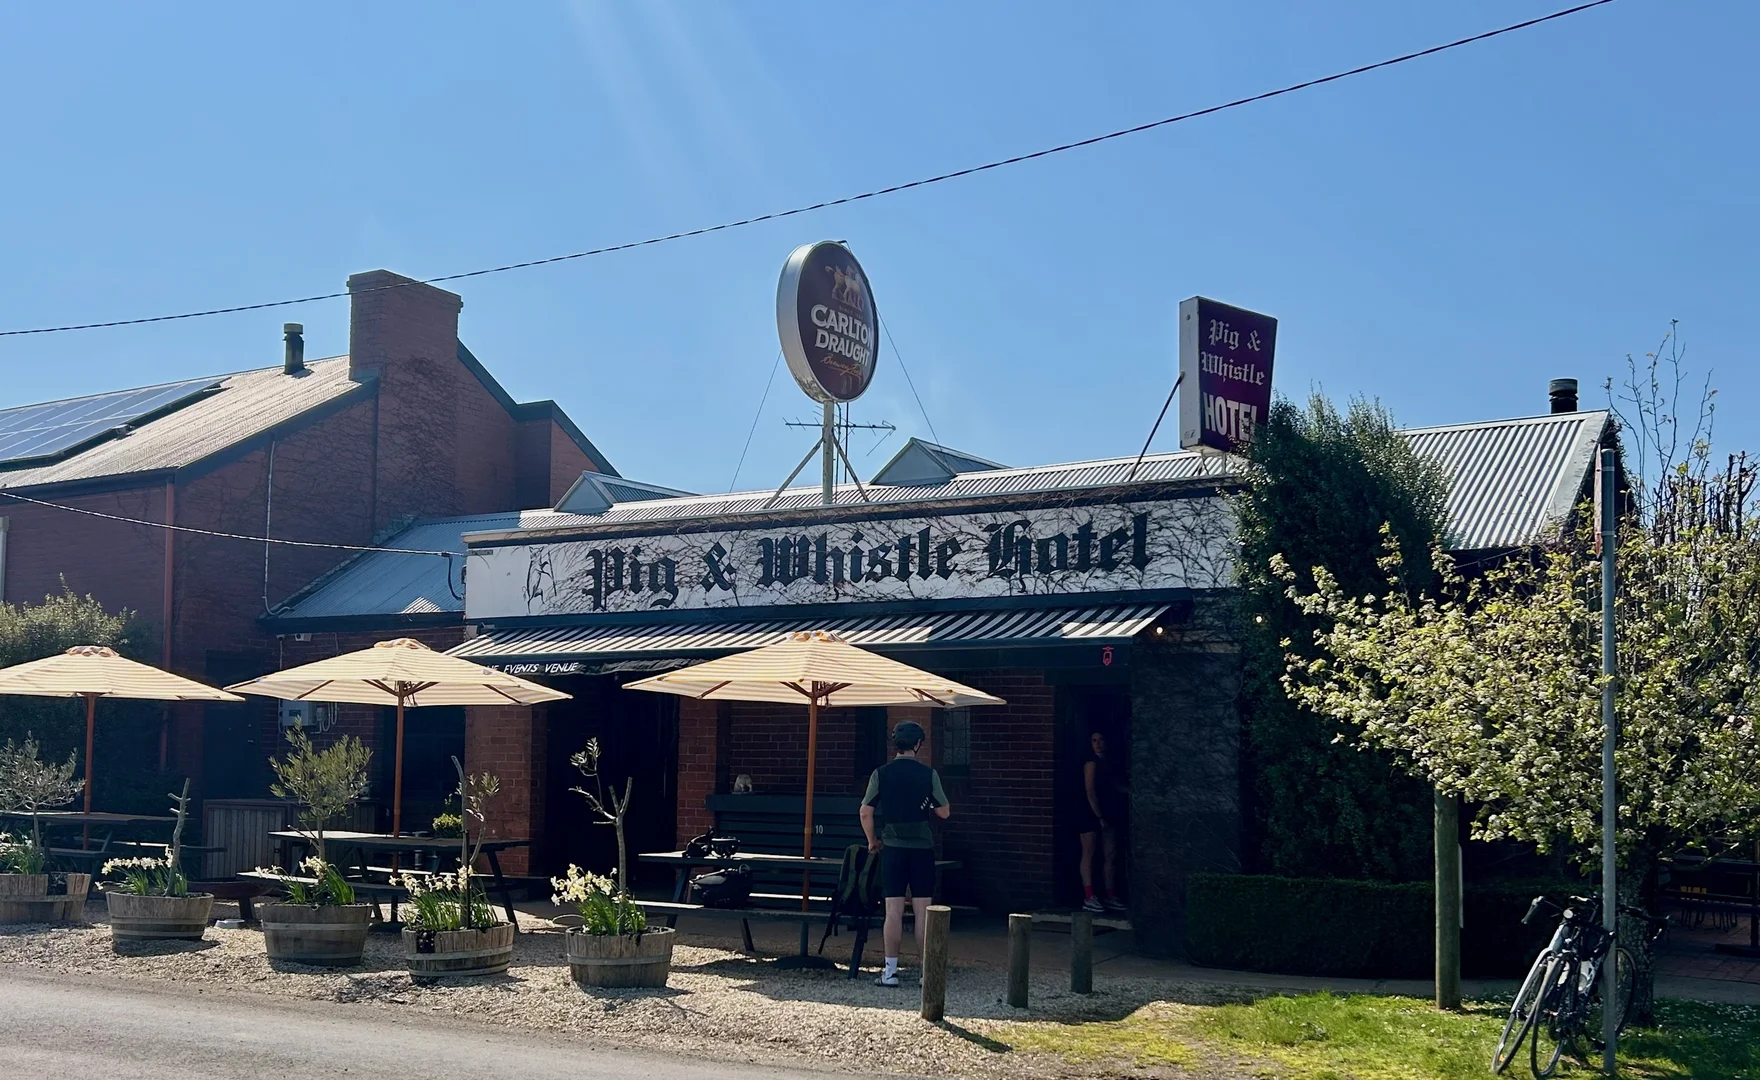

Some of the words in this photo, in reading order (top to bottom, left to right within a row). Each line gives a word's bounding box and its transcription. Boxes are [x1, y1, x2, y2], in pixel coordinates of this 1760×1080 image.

[811, 304, 872, 350] CARLTON
[1208, 319, 1240, 351] Pig
[1247, 330, 1262, 352] &
[815, 328, 870, 367] DRAUGHT
[1201, 351, 1265, 386] Whistle
[582, 545, 679, 611] Pig
[700, 541, 736, 593] &
[754, 526, 963, 600] Whistle
[983, 511, 1153, 593] Hotel
[503, 663, 540, 674] EVENTS
[544, 662, 579, 673] VENUE
[815, 824, 824, 835] 10
